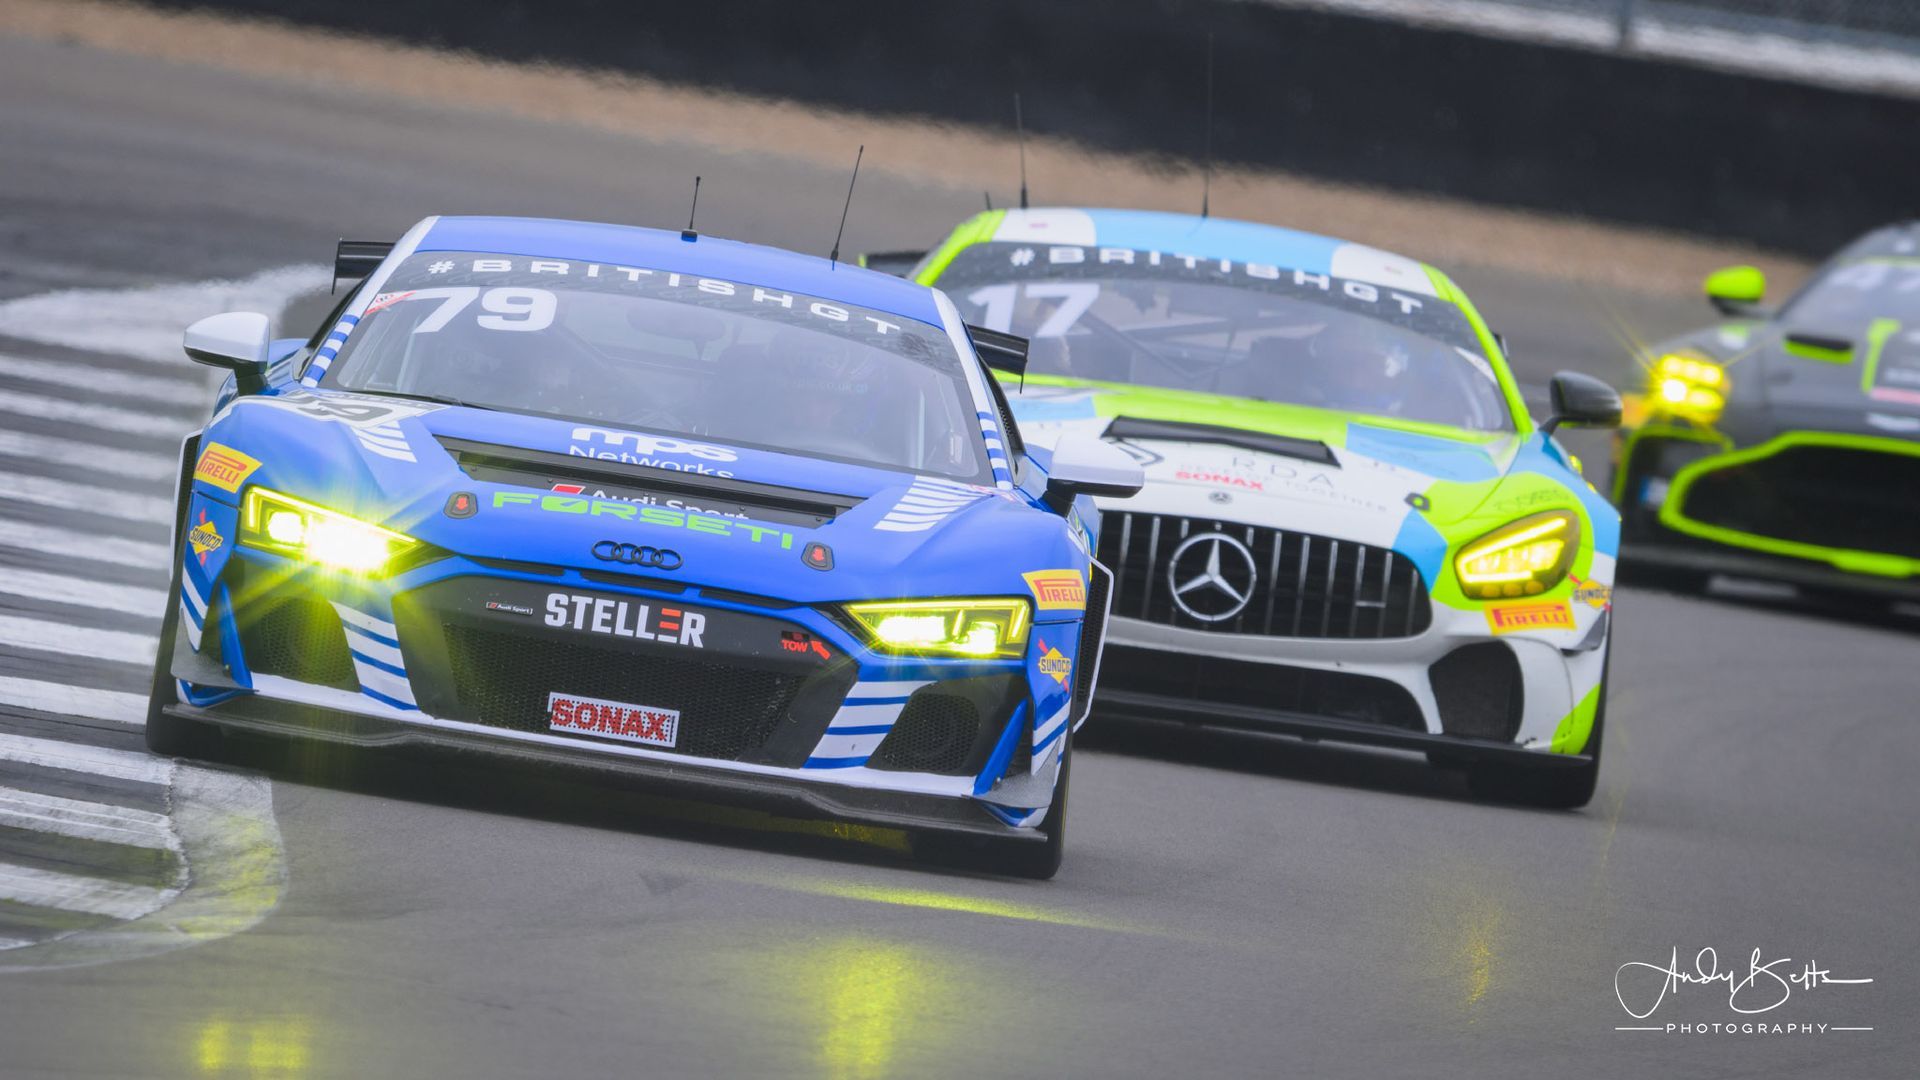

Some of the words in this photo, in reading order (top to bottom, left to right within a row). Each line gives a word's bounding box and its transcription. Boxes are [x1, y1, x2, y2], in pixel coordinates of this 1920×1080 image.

[428, 259, 901, 335] #BRITISHGT
[1010, 246, 1423, 315] #BRITISHGT
[400, 286, 558, 335] 79
[967, 282, 1100, 338] 17
[571, 427, 739, 463] mps
[196, 450, 248, 485] PIRELLI
[1175, 471, 1264, 491] SONAX
[189, 526, 222, 551] SUNOCO
[1033, 578, 1085, 603] PIRELLI
[544, 593, 706, 648] STELLER
[1492, 605, 1569, 628] PIRELLI
[781, 639, 808, 653] TOW
[1040, 658, 1071, 674] SUNOCO
[551, 698, 667, 741] SONAX
